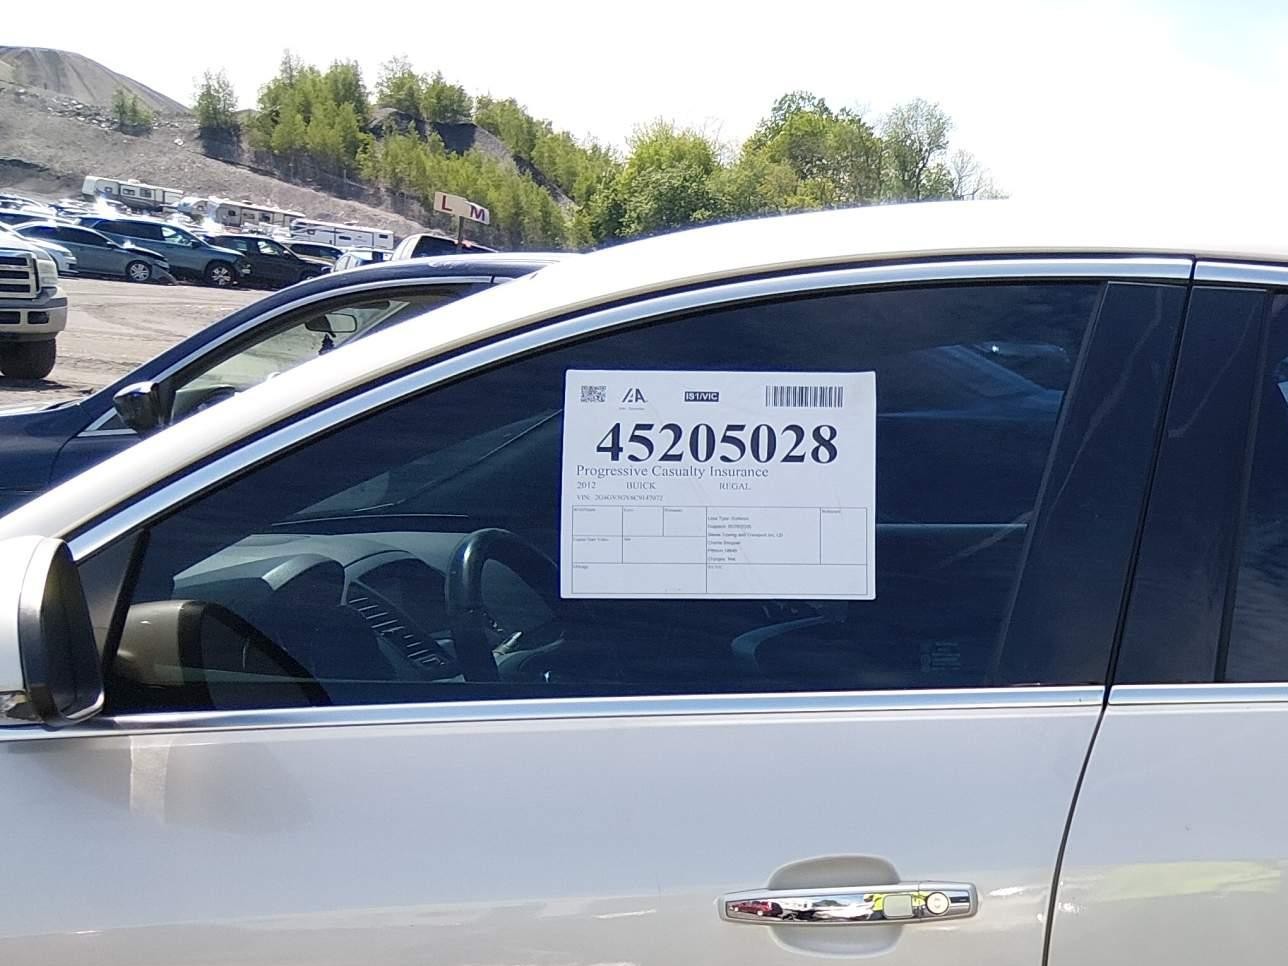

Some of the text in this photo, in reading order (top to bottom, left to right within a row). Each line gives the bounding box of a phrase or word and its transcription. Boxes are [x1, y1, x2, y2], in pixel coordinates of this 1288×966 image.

[441, 195, 486, 221] L M
[596, 423, 838, 464] 45205028
[576, 465, 769, 479] Progressive Casualty Insurance
[576, 481, 751, 491] 2012 BUICK REGAL
